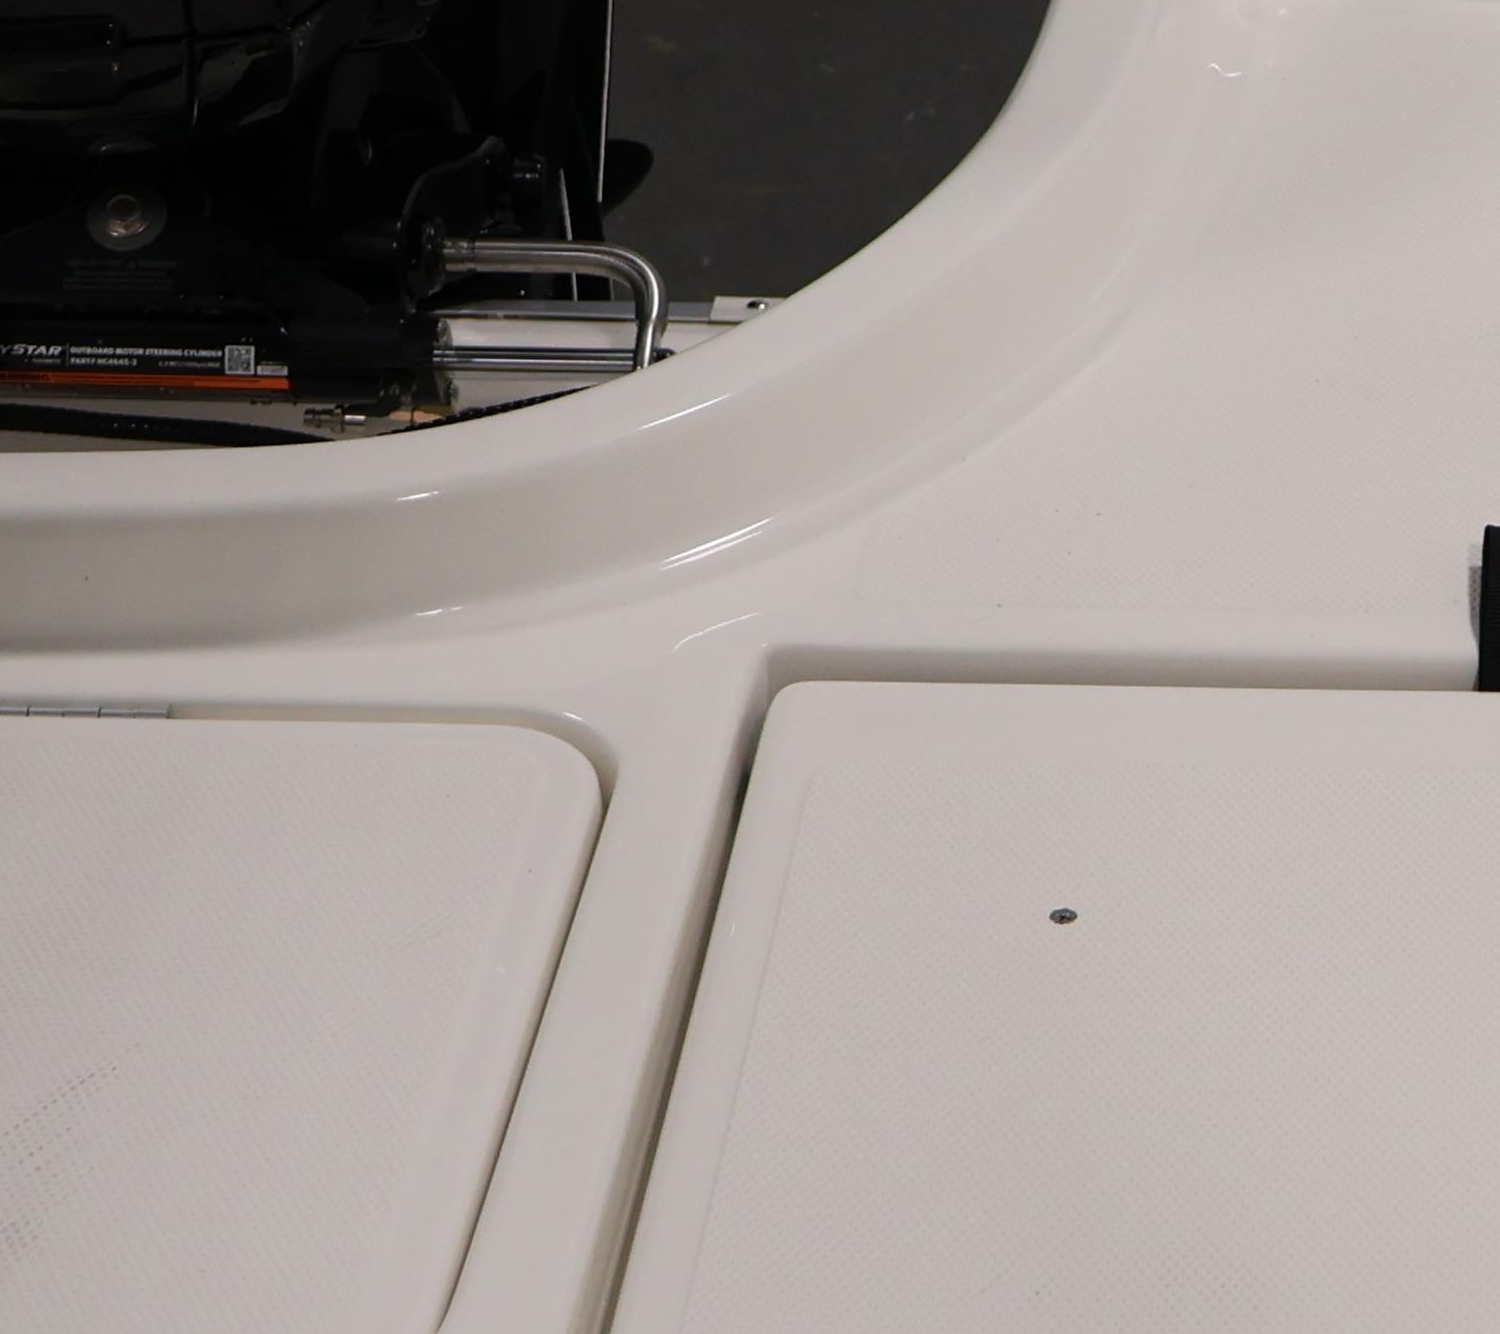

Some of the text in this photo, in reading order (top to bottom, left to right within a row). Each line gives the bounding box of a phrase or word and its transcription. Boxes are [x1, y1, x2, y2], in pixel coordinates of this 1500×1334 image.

[70, 346, 224, 358] OUTBOARD MOTOR STEERING CYLINDER
